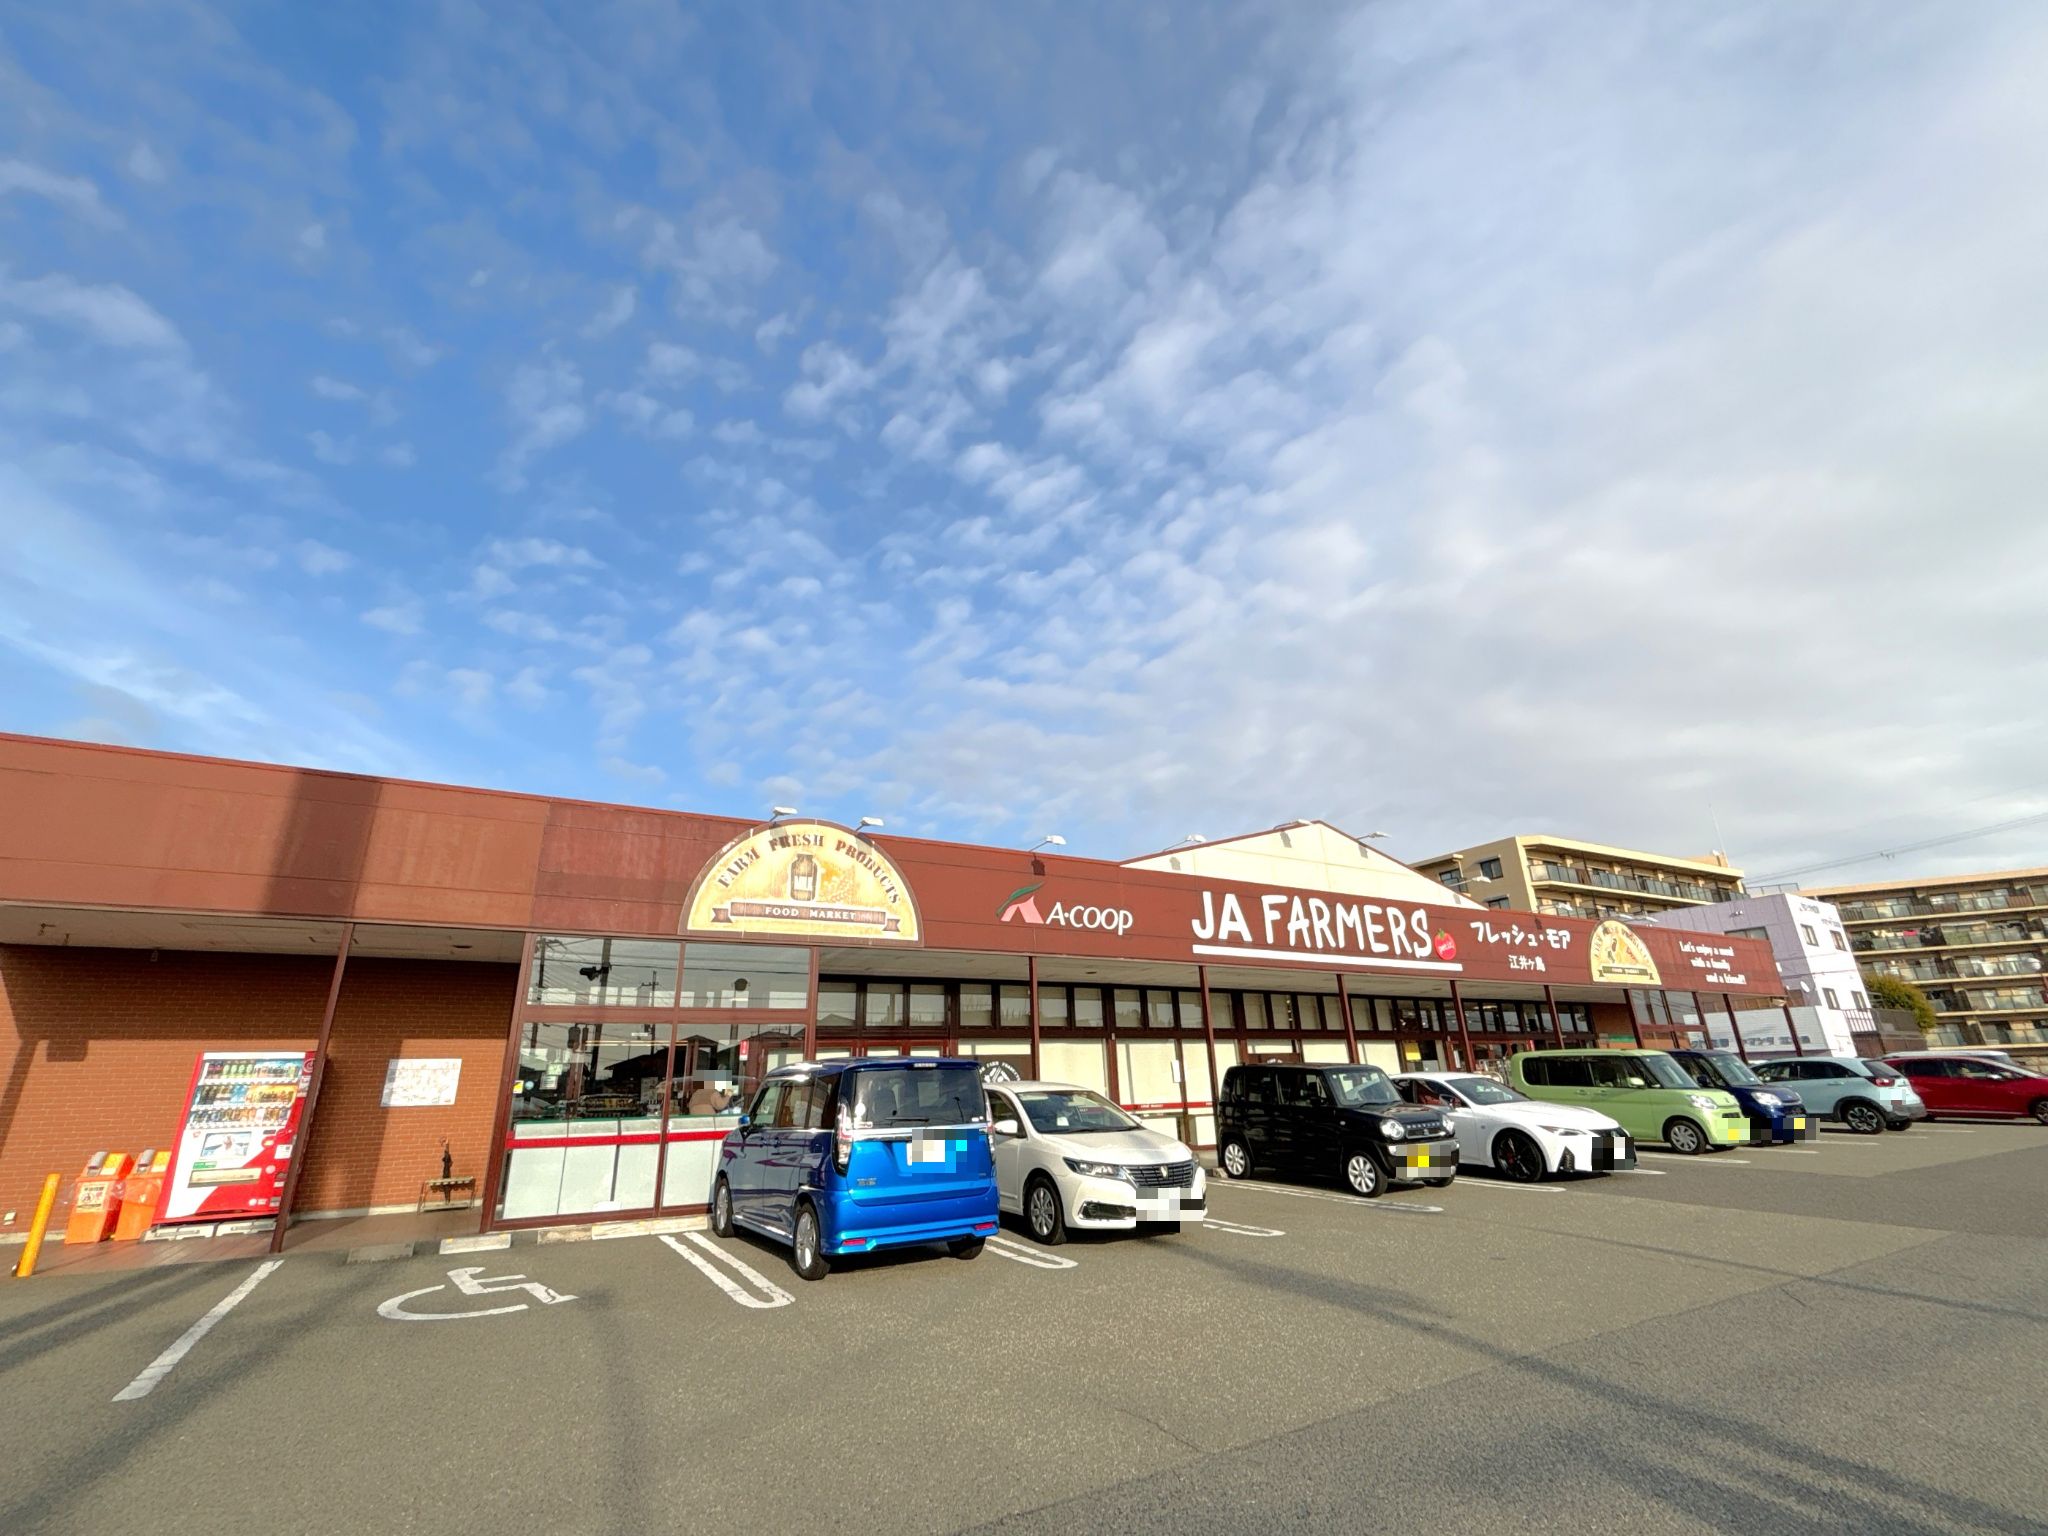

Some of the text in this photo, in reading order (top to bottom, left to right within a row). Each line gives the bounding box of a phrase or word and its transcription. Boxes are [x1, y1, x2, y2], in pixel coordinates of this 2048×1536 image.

[717, 833, 901, 904] FARM FRESH PRODUCTS
[765, 906, 856, 921] FOOD MARKET
[1192, 890, 1433, 959] JA FARMERS
